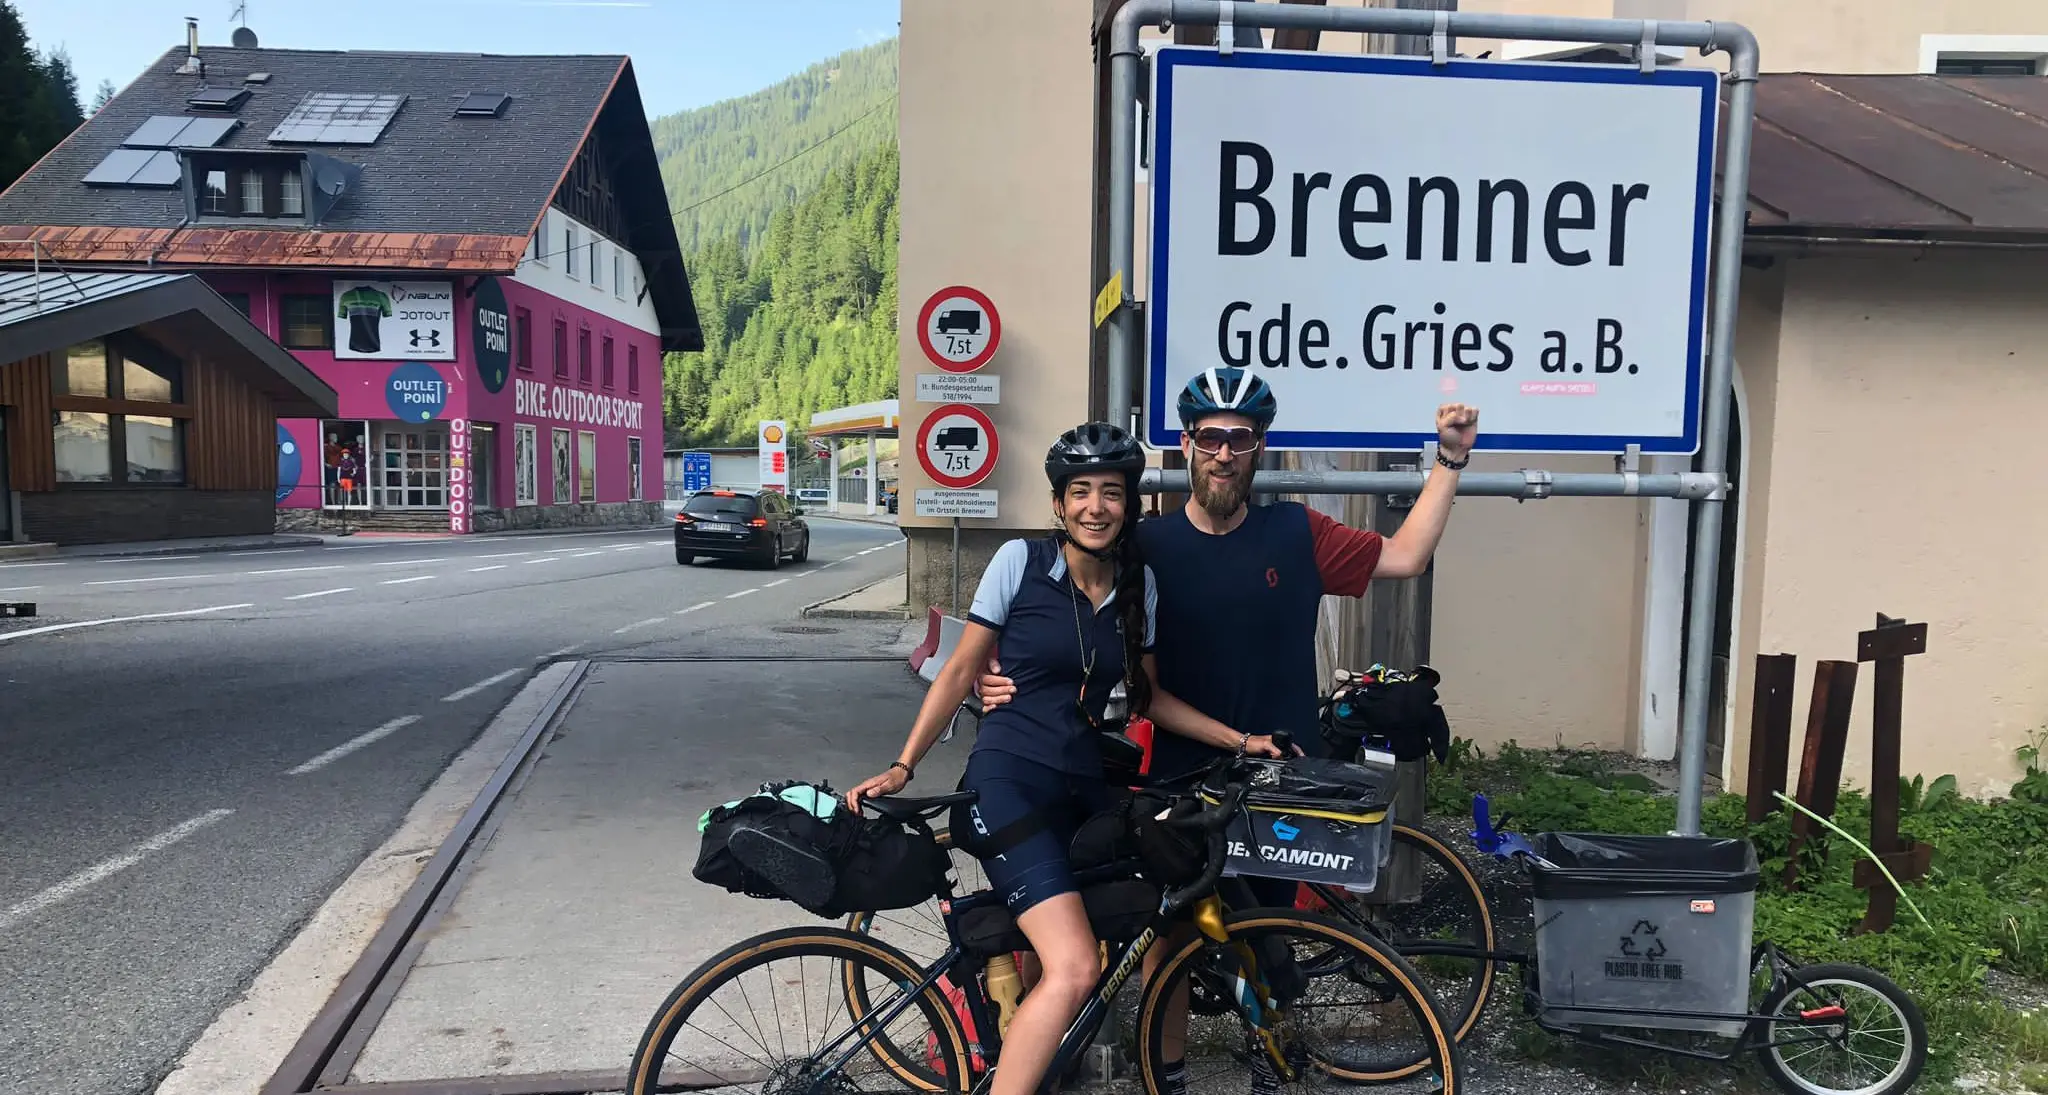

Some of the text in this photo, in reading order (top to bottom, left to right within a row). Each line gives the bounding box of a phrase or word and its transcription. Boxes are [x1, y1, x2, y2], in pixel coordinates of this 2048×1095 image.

[1218, 140, 1650, 267] Brenner
[479, 308, 508, 333] OUTLET
[485, 330, 508, 354] POINT
[946, 336, 972, 355] 7,5t
[1218, 301, 1348, 369] Gde.
[1363, 302, 1515, 373] Gries
[393, 380, 443, 394] OUTLET
[403, 391, 442, 404] POINT
[612, 397, 643, 430] SPORT
[945, 452, 971, 472] 7,5t
[450, 418, 465, 531] OUTDOOR
[1226, 841, 1354, 871] BEGAMONT
[1604, 961, 1683, 980] PLASTIC FREE RIDE
